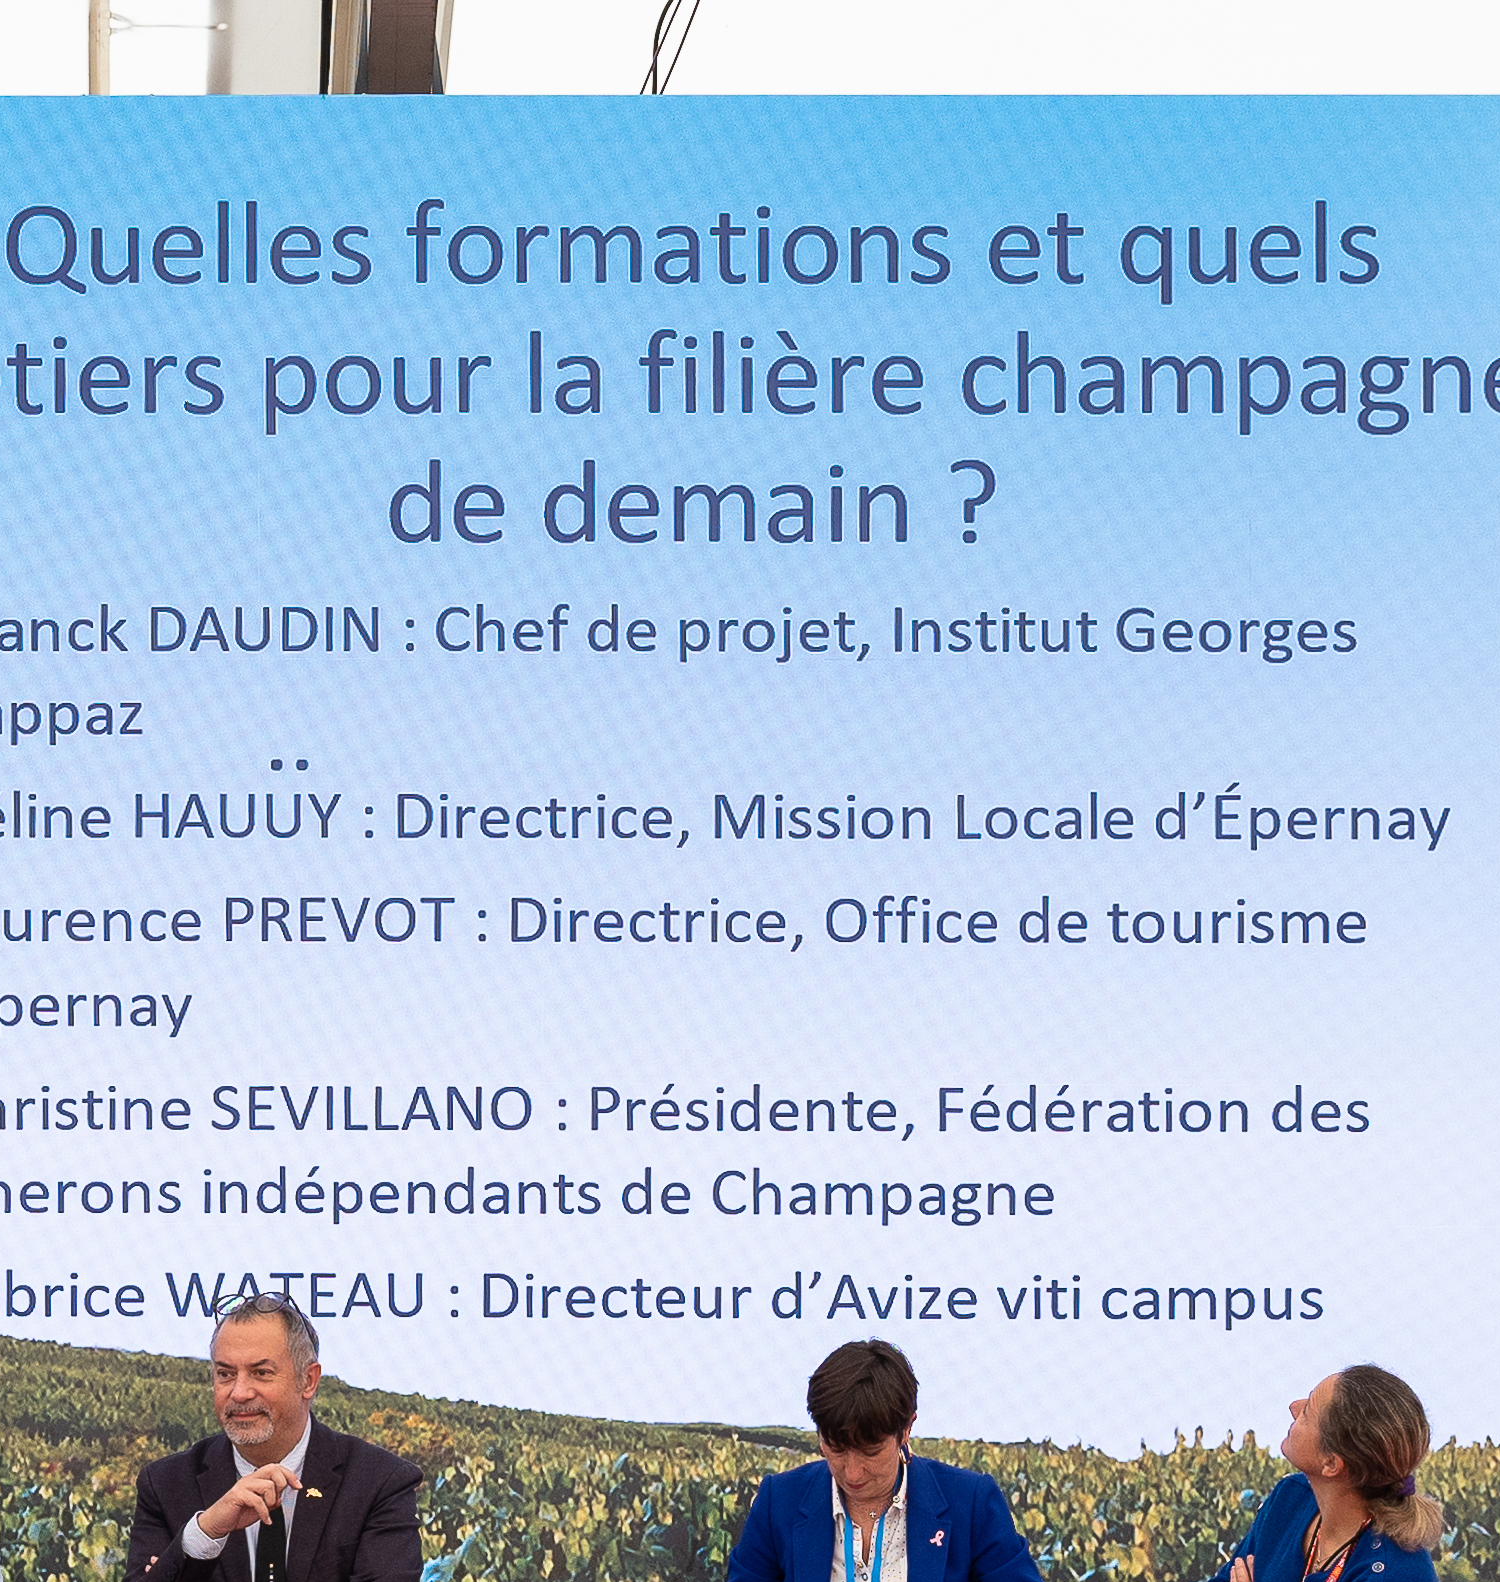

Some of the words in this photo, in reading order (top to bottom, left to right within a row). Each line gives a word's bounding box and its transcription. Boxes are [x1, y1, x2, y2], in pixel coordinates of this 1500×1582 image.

[5, 201, 371, 294] Quelles
[405, 199, 950, 286] formations
[989, 213, 1085, 284] et
[1121, 200, 1379, 305] quels
[266, 356, 491, 435] pour
[530, 331, 600, 414] la
[639, 329, 923, 415] filière
[389, 459, 504, 543] de
[544, 460, 907, 543] demain
[951, 460, 995, 543] ?
[151, 607, 379, 652] DAUDIN
[436, 604, 569, 652] Chef
[588, 604, 656, 652] de
[680, 607, 870, 663] projet,
[895, 607, 1097, 652] Institut
[1117, 608, 1357, 663] Georges
[397, 794, 689, 848] Directrice,
[715, 794, 930, 839] Mission
[957, 792, 1133, 839] Locale
[226, 897, 455, 942] PREVOT
[511, 898, 802, 952] Directrice,
[826, 895, 997, 943] Office
[1020, 896, 1087, 943] de
[1107, 899, 1366, 943] tourisme
[212, 1086, 532, 1130] SEVILLANO
[591, 1084, 914, 1141] Présidente,
[939, 1084, 1248, 1132] Fédération
[1272, 1085, 1369, 1132] des
[204, 1166, 601, 1224] indépendants
[622, 1167, 690, 1214] de
[713, 1167, 1054, 1226] Champagne
[483, 1273, 751, 1319] Directeur
[997, 1275, 1080, 1319] viti
[1102, 1288, 1323, 1331] campus
